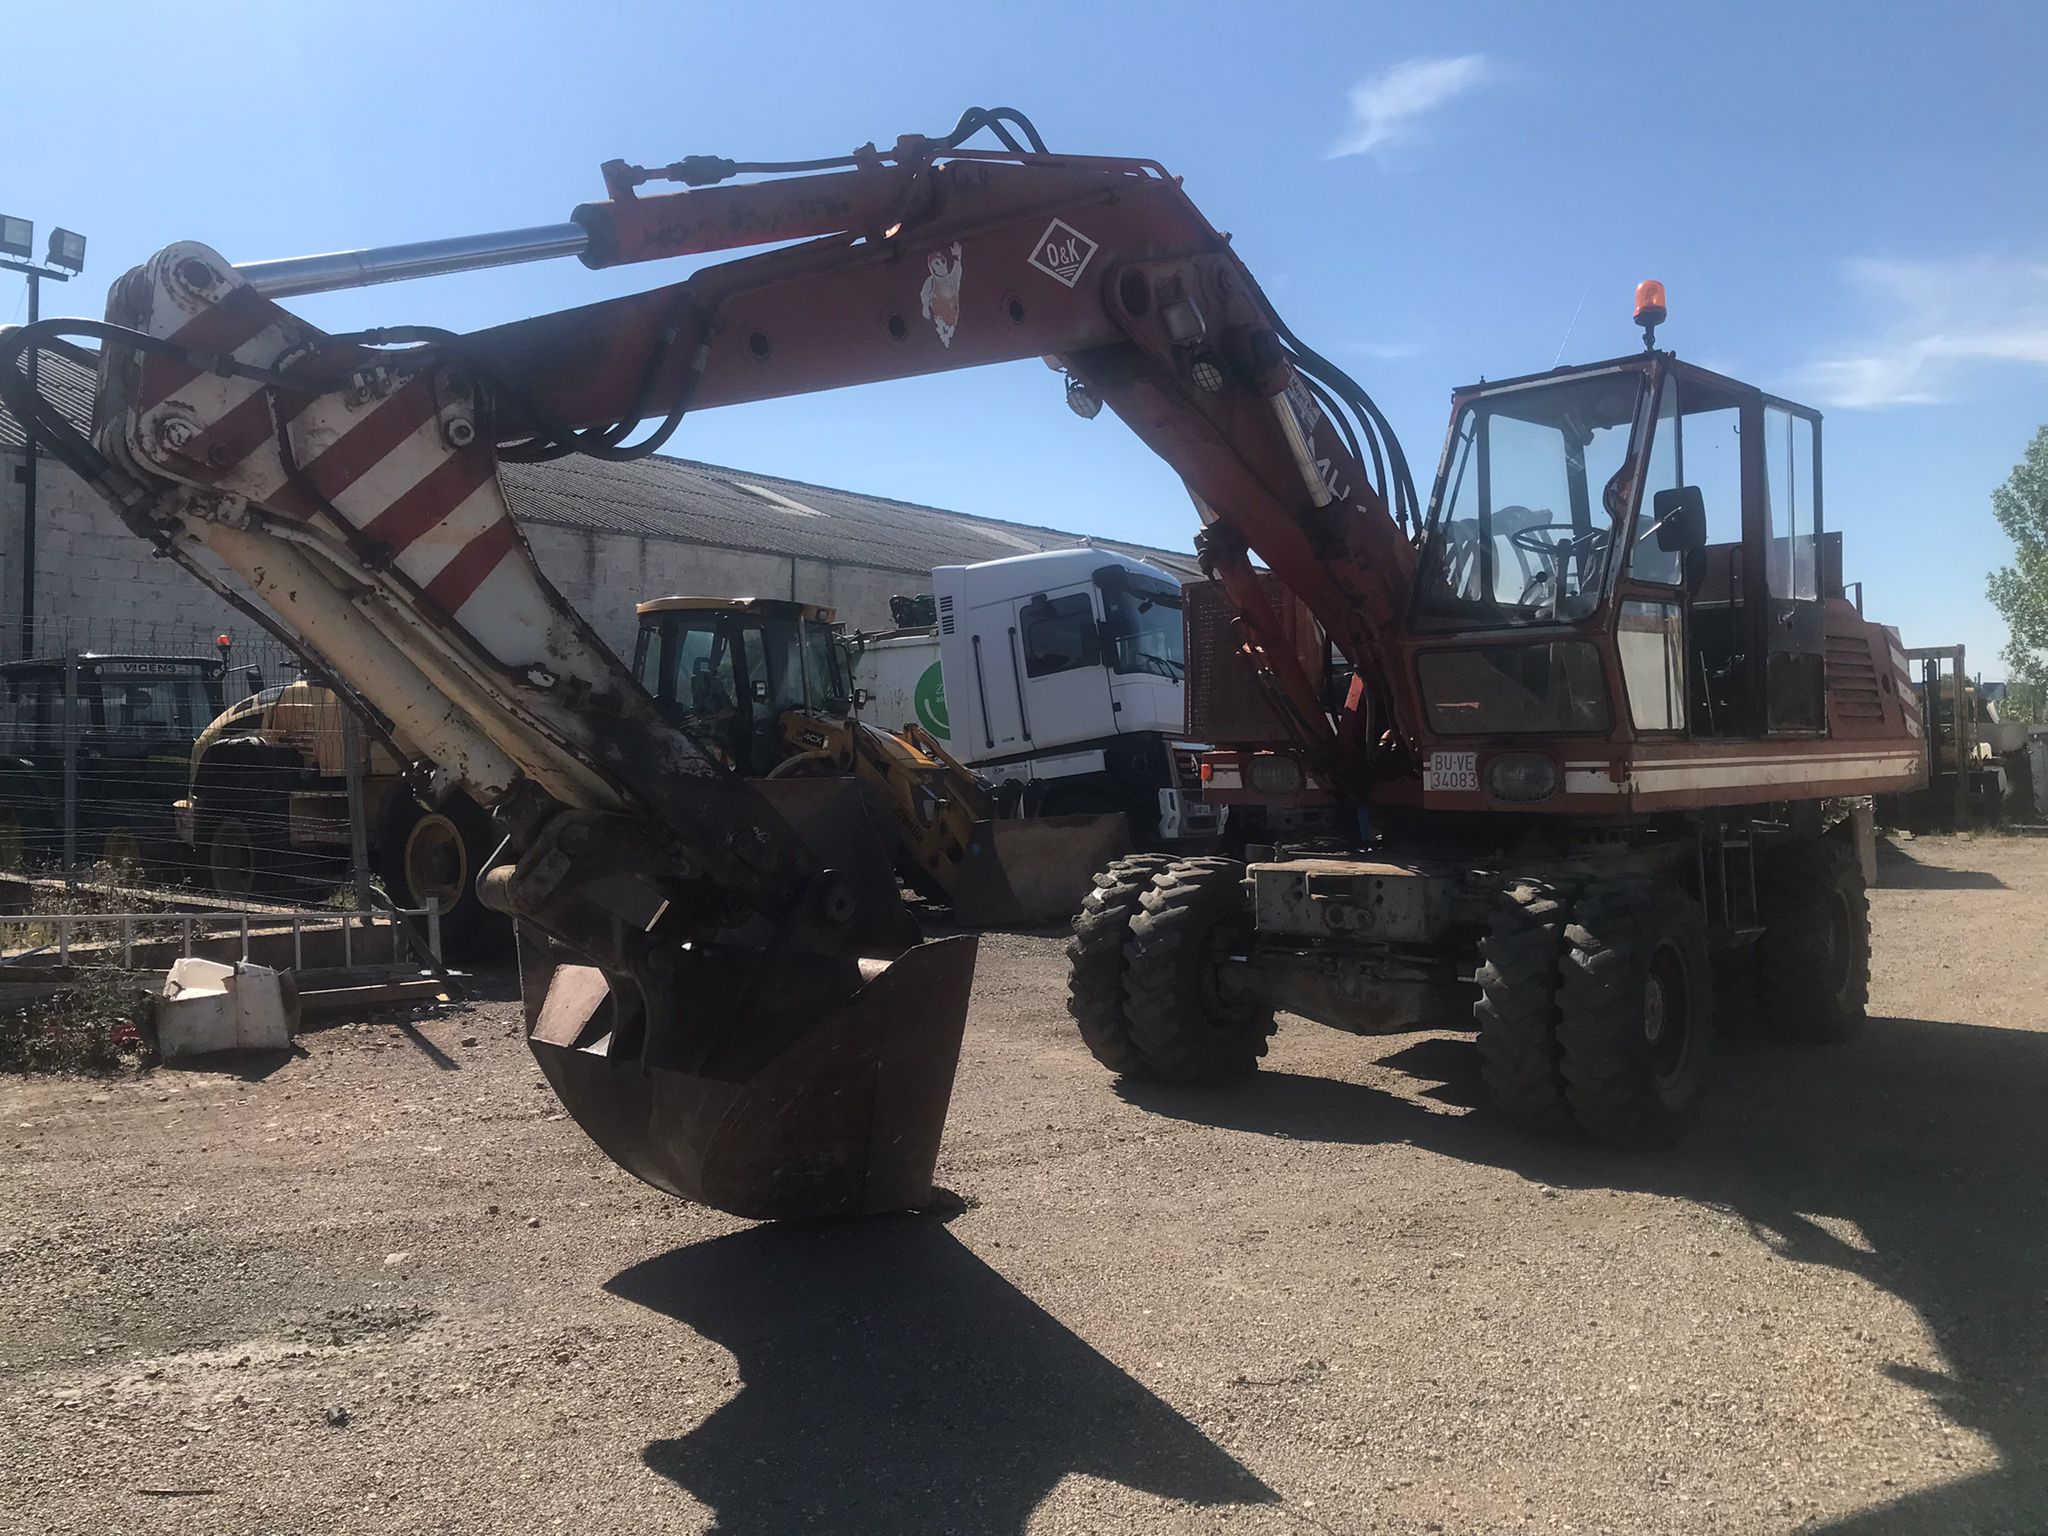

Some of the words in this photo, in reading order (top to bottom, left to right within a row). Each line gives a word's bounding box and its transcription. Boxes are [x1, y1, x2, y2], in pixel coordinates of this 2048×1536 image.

[1046, 238, 1081, 267] O&K
[124, 664, 176, 672] VICENS
[1433, 772, 1476, 788] 34083
